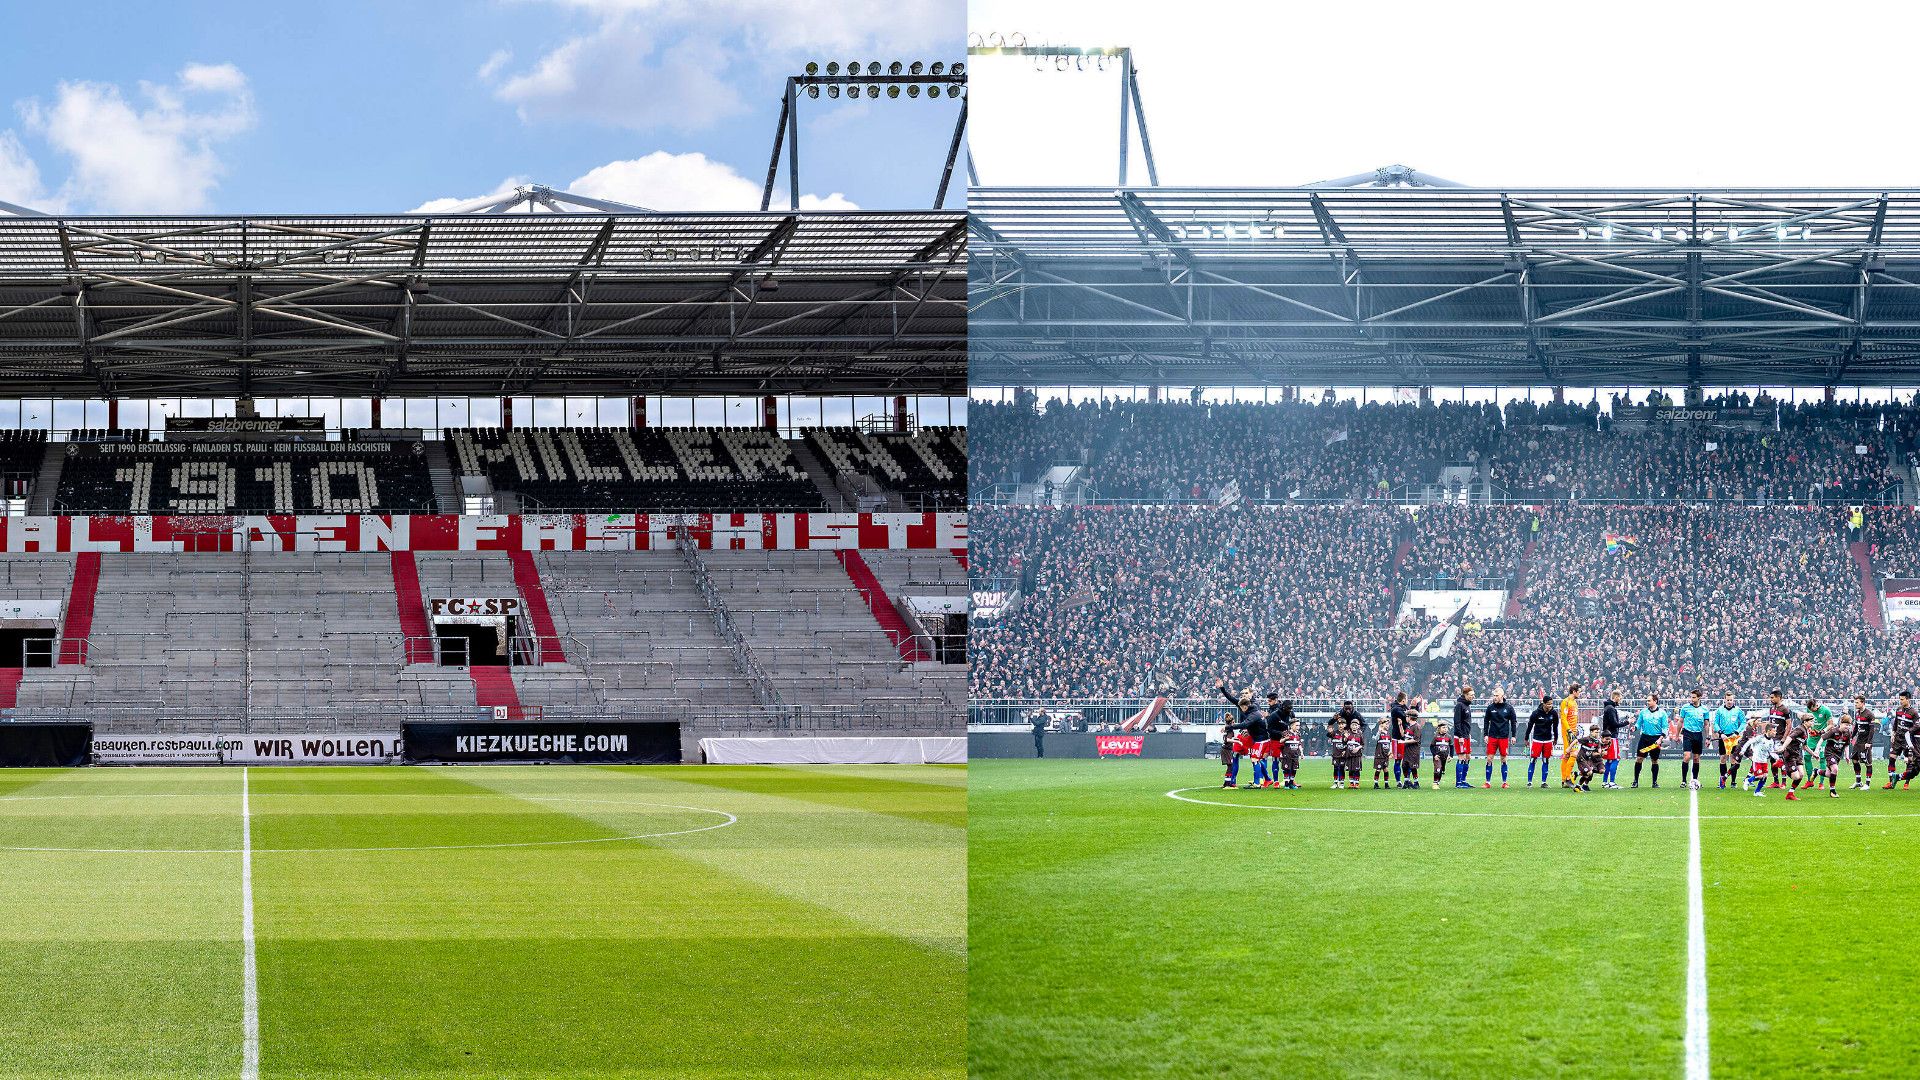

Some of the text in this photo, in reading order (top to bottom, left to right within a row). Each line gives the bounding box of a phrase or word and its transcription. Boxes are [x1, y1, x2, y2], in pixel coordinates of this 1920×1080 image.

[207, 418, 283, 431] salzbrenner
[100, 443, 391, 453] SEIT 1990 ERSTKLASSIG FANLADEN ST. PAULI KEIN FUSSBALL DEN FASCHISTEN
[115, 462, 379, 513] 1910
[430, 598, 518, 615] FC SP
[253, 739, 294, 759] WIR
[456, 734, 628, 753] KIEZKUECHE.COM
